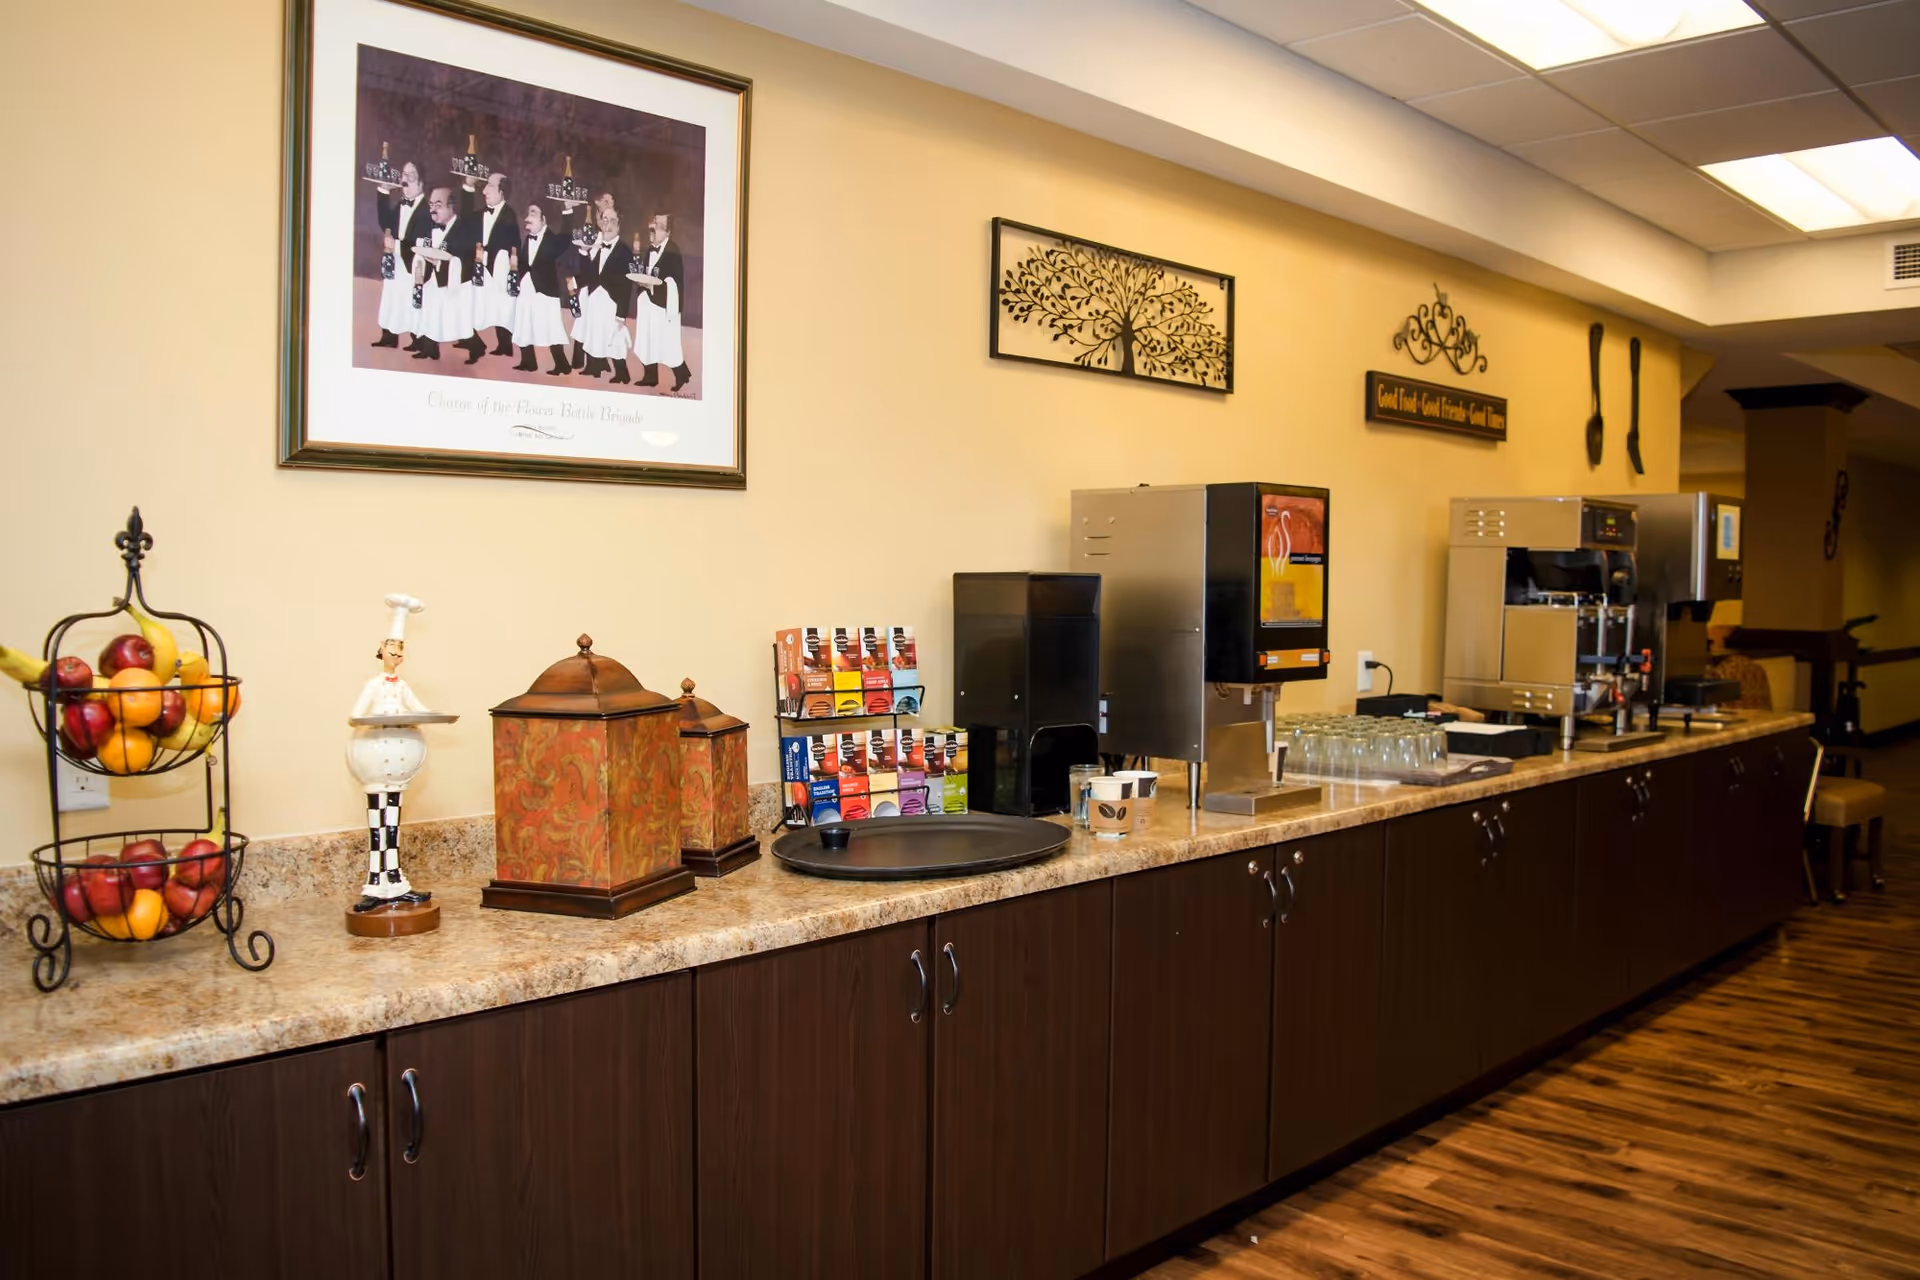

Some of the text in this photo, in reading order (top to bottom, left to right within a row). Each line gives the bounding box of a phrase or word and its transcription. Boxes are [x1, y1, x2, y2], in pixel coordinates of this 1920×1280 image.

[476, 396, 490, 417] of
[493, 399, 512, 414] the
[561, 400, 595, 420] Bottle
[601, 405, 644, 425] Brigade
[1378, 383, 1398, 410] Good
